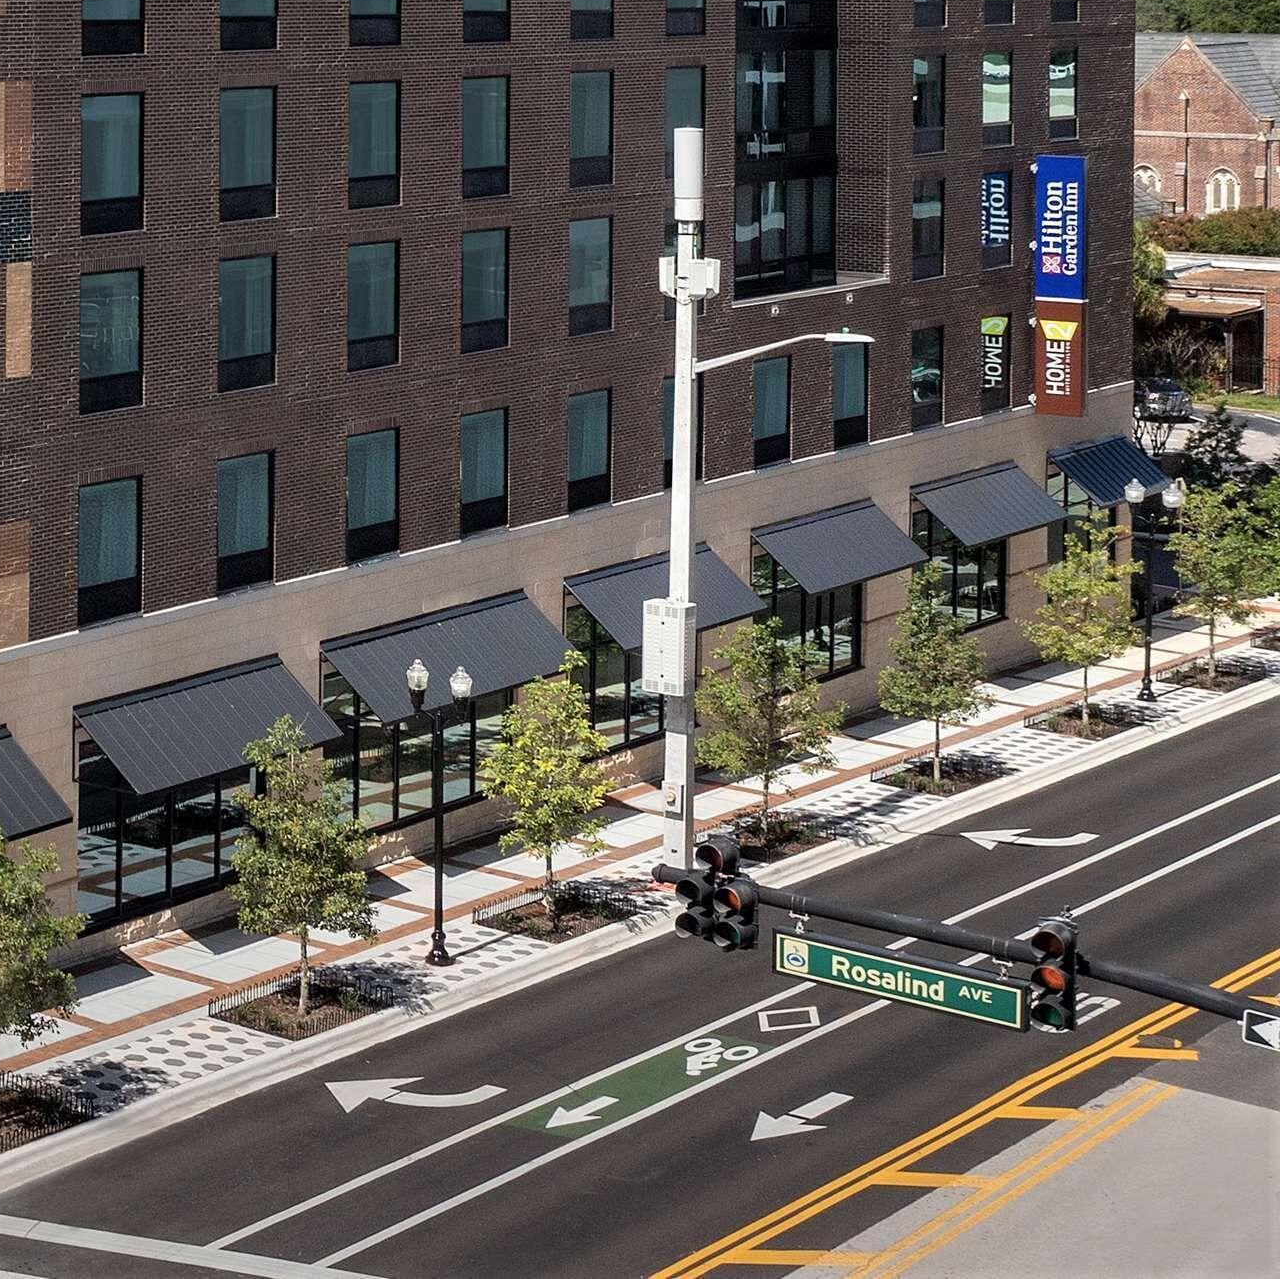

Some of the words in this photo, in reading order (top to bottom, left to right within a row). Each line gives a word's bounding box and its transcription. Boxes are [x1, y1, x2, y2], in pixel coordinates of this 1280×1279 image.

[1041, 181, 1063, 255] Hilton
[1063, 182, 1078, 212] Inn
[1062, 214, 1078, 276] Garden
[1045, 323, 1072, 339] 2
[1045, 340, 1065, 395] HOME
[831, 954, 945, 1002] Rosalind
[958, 986, 993, 1004] AVE
